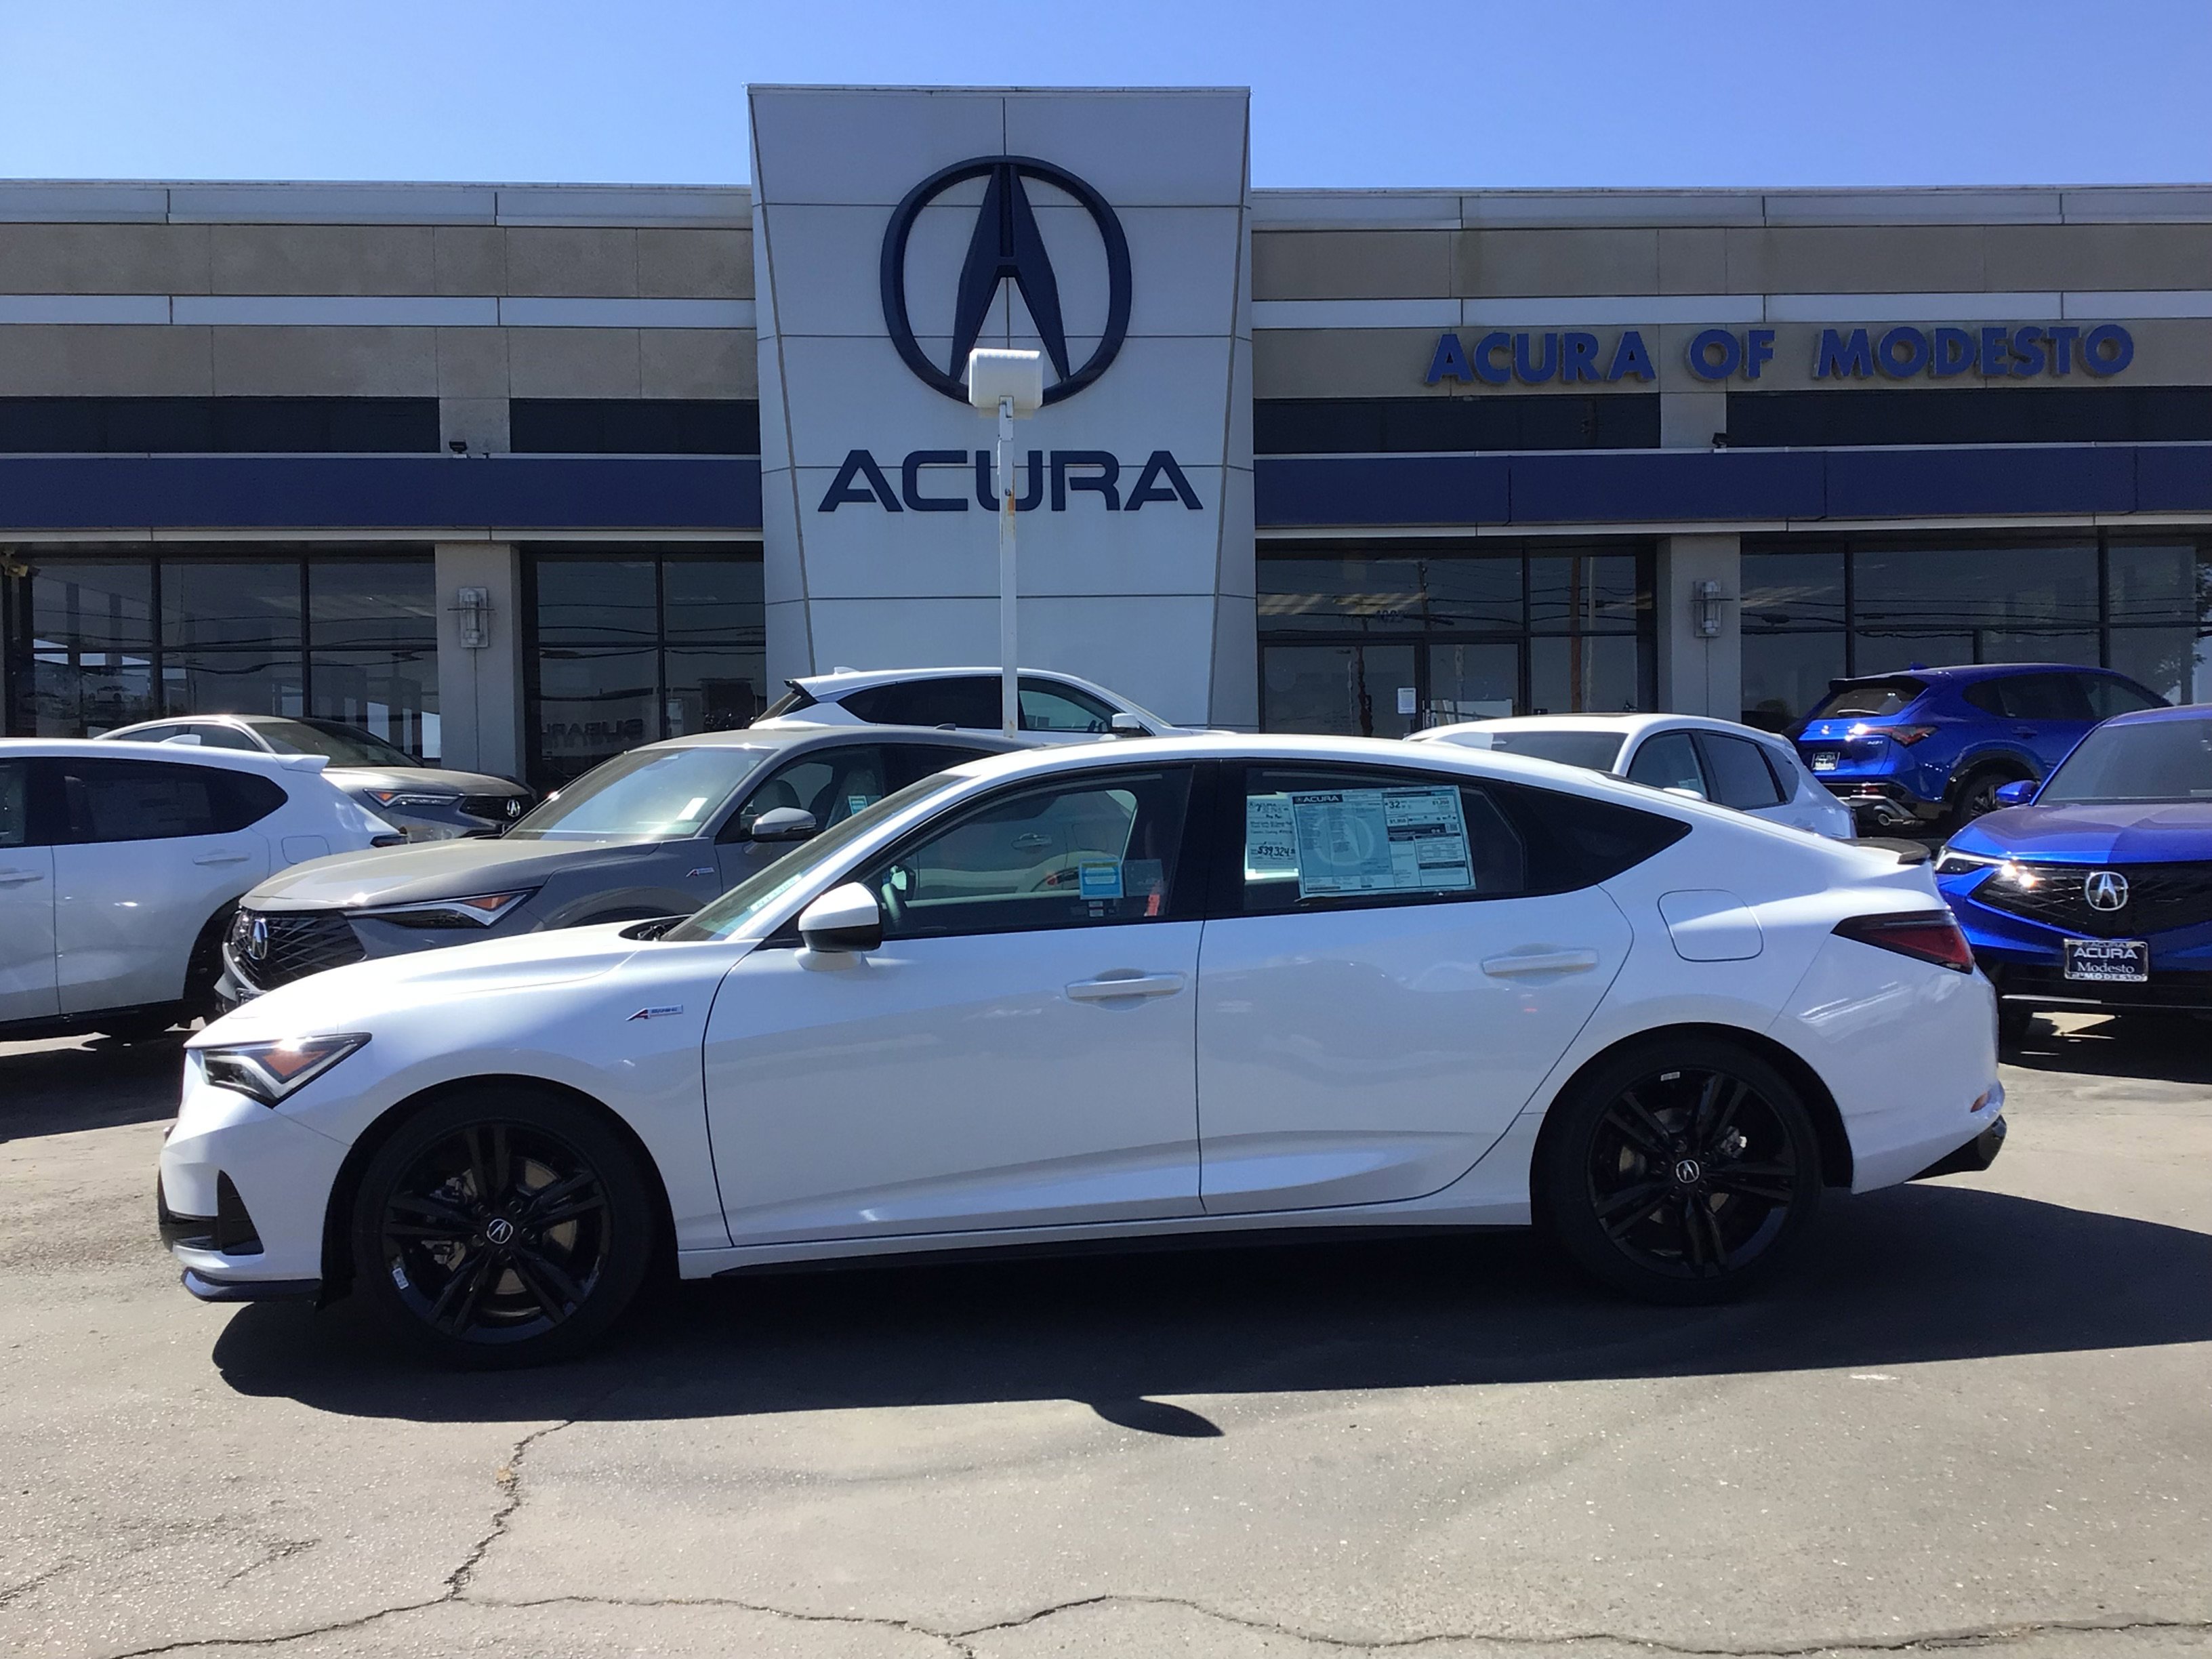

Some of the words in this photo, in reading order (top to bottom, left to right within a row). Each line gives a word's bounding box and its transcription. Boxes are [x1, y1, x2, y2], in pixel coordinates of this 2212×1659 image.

[1426, 330, 1656, 384] ACURA
[1687, 328, 1776, 382] OF
[1813, 323, 2135, 380] MODESTO
[817, 449, 1203, 512] ACURA
[1389, 800, 1400, 808] 32
[2073, 947, 2138, 959] ACURA
[2076, 961, 2135, 973] Modesto
